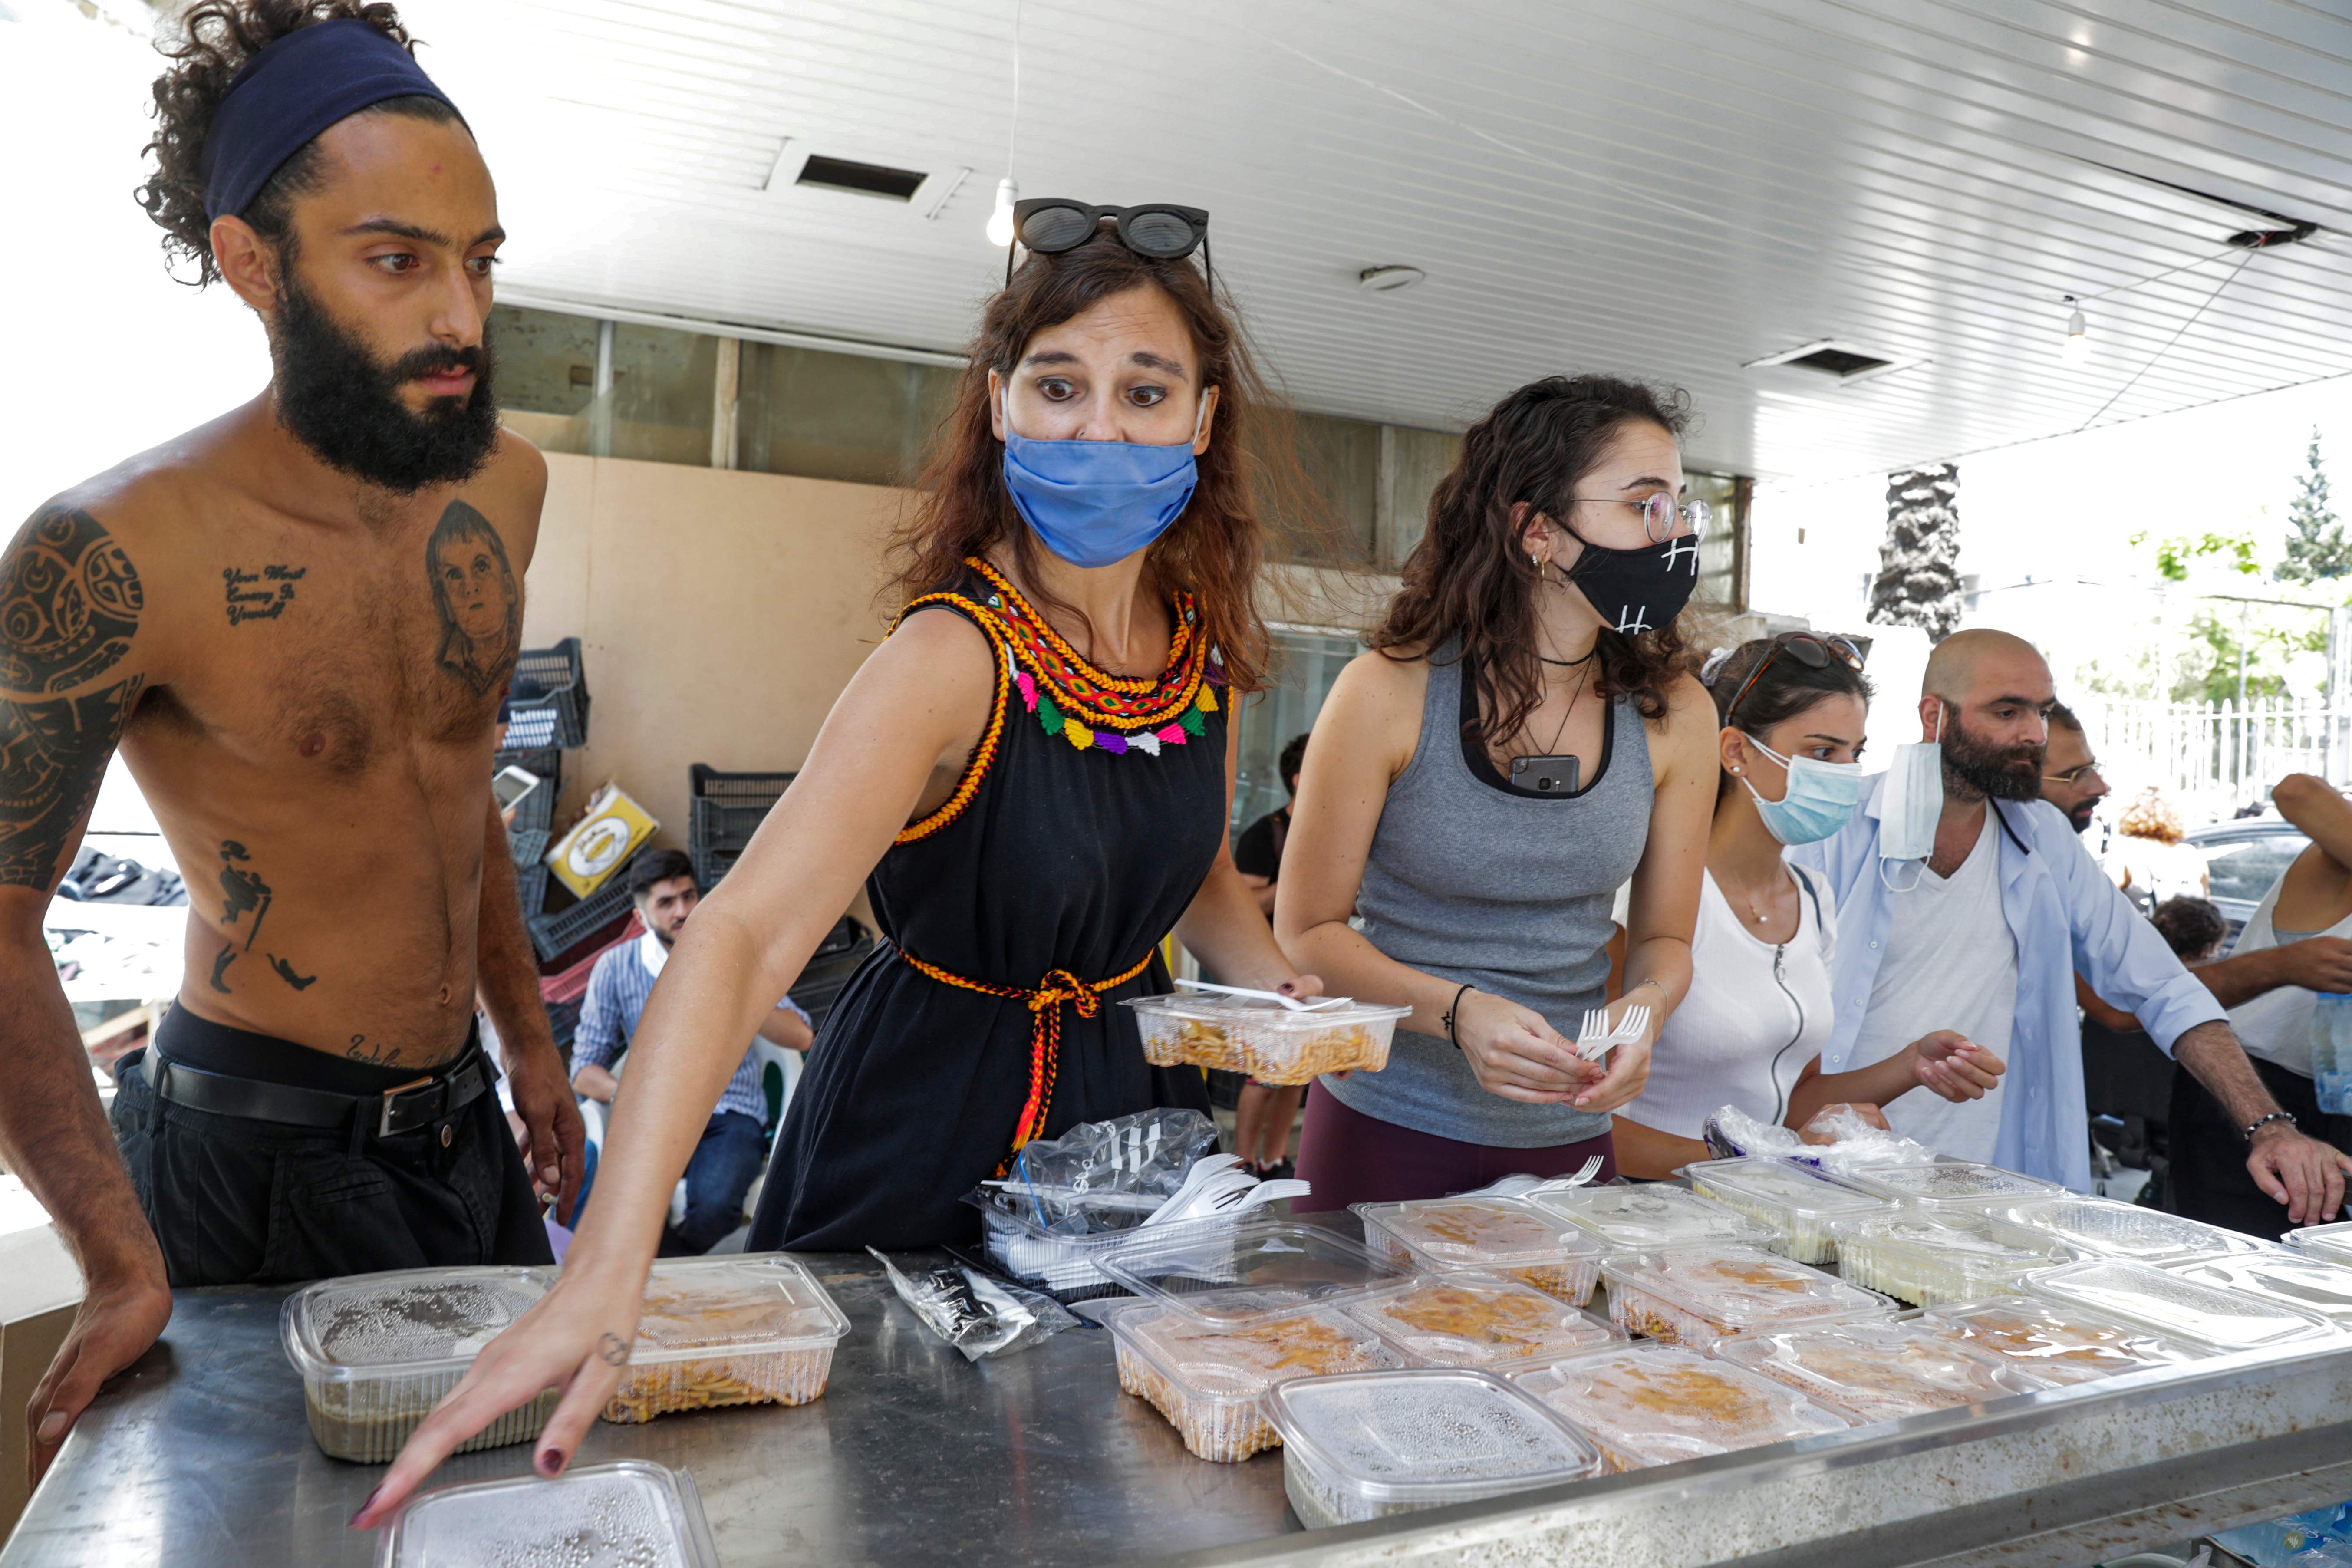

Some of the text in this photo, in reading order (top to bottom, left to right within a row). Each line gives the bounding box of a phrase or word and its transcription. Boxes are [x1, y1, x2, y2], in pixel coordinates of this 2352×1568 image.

[264, 565, 306, 580] Worst
[279, 583, 295, 600] Is
[227, 601, 285, 626] Yourself
